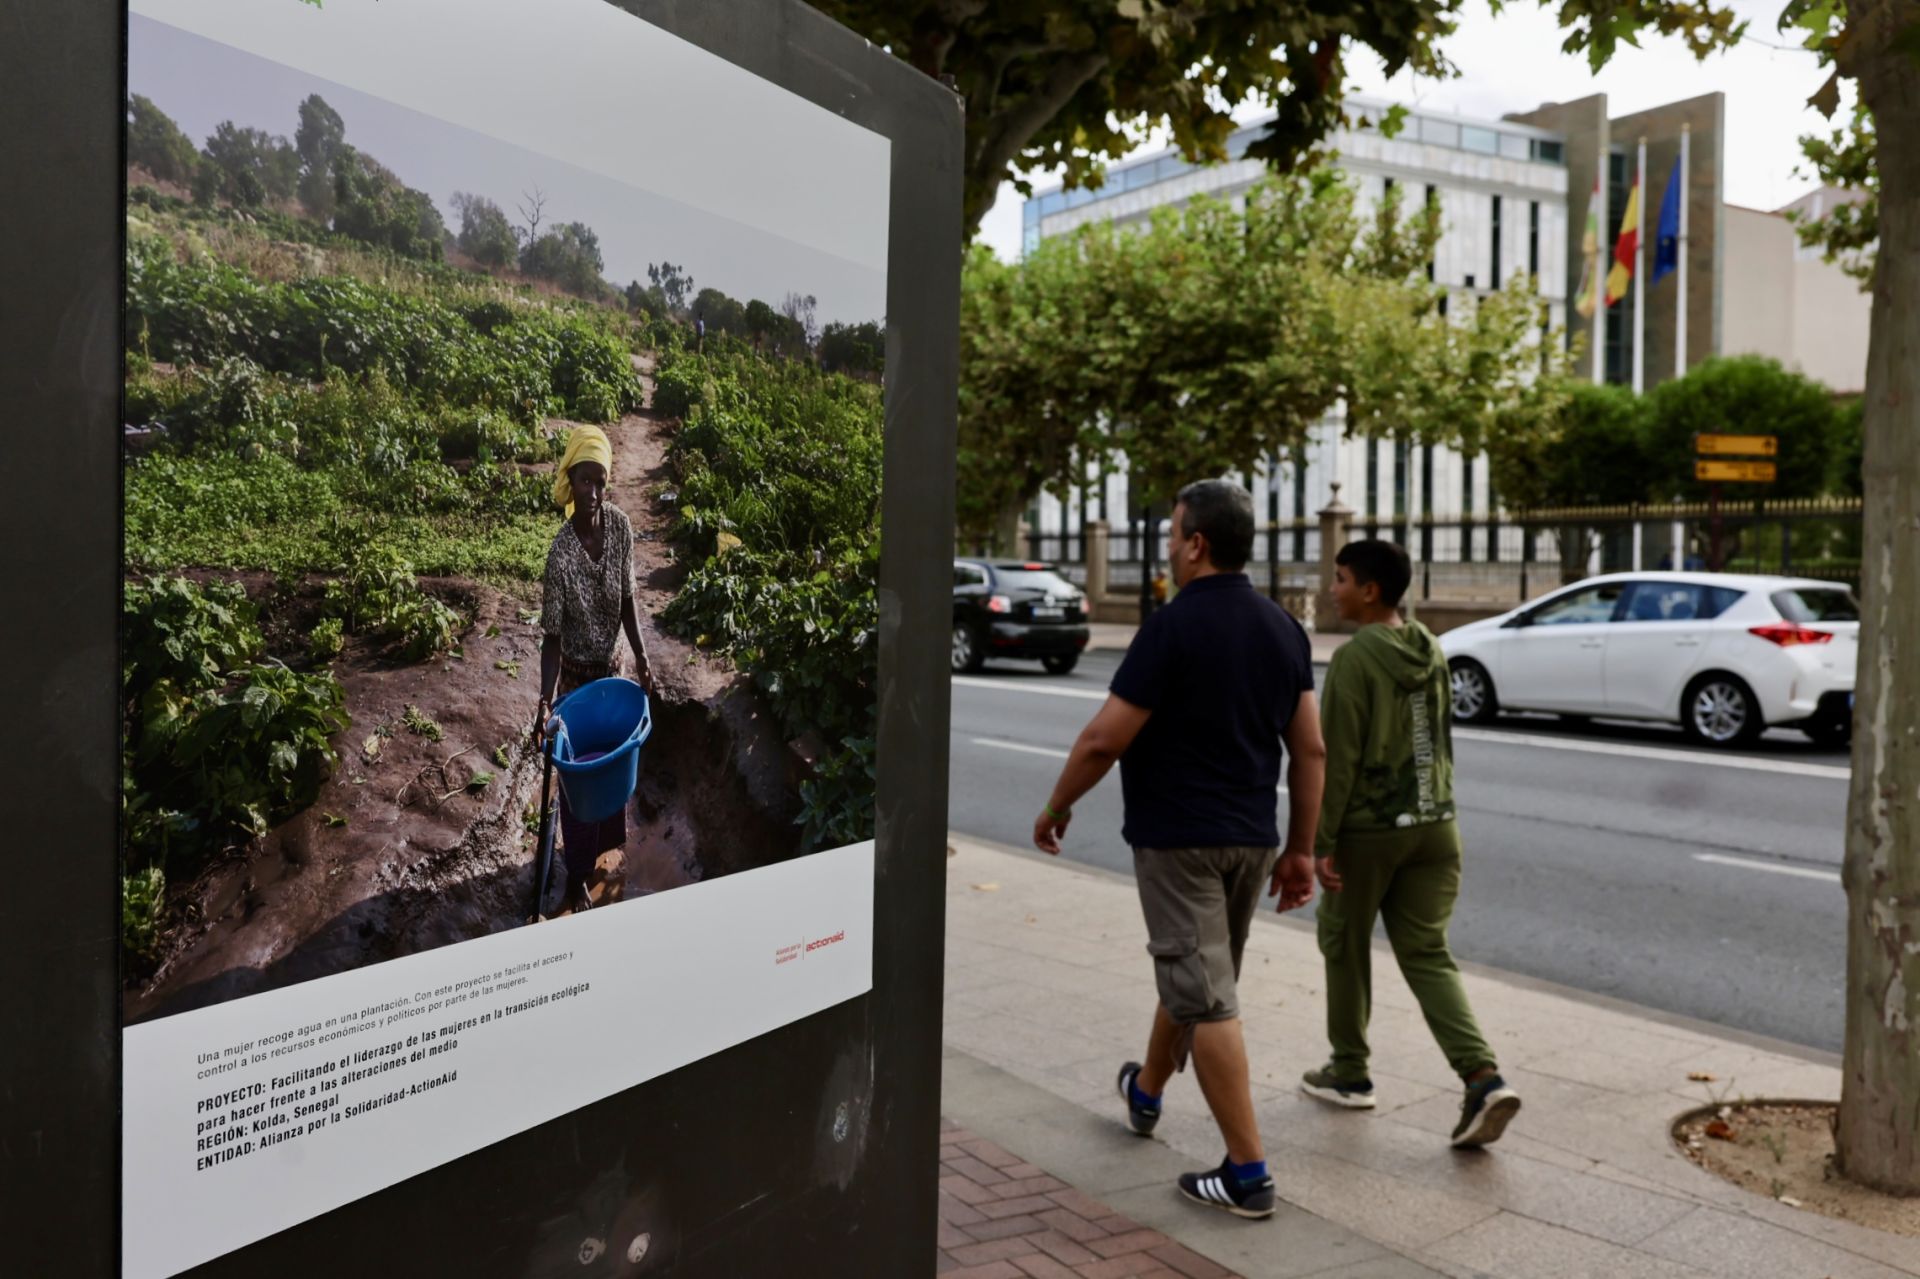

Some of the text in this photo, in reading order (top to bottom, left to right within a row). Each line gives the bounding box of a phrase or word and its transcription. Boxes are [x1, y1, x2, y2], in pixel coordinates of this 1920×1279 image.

[806, 930, 844, 952] actionaid
[197, 951, 574, 1065] Una mujer recoge agua en una plantación. Con este proyecto se facilita el acceso y
[197, 977, 528, 1079] control a los recursos económicos y políticos por parte de las mujeres.
[197, 982, 590, 1114] PROYECTO: Facilitando el liderazgo de las mujeres en la transición ecológica
[197, 1038, 458, 1135] para hacer frente a las alteraciones del medio
[197, 1071, 457, 1171] ENTIDAD: Alianza por la Solidaridad-ActionAid
[197, 1094, 339, 1152] REGIÓN: Kolda, Senegal
